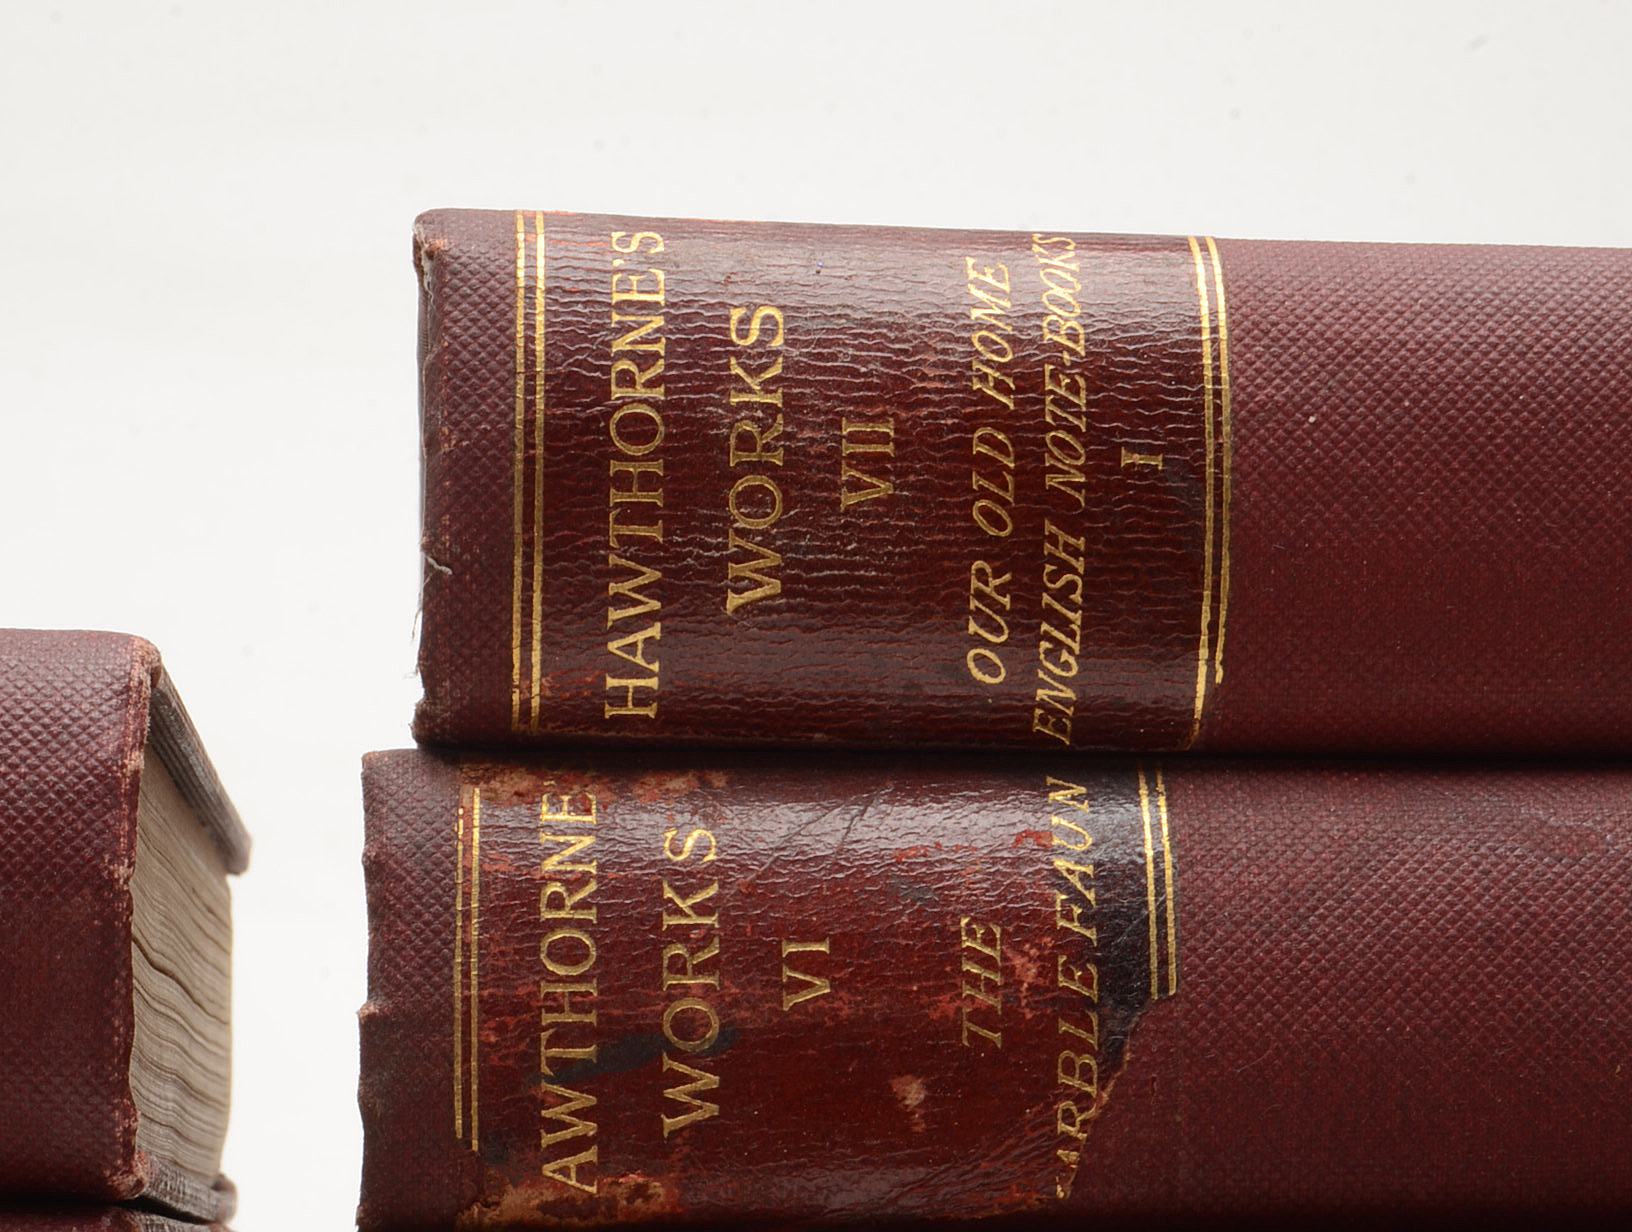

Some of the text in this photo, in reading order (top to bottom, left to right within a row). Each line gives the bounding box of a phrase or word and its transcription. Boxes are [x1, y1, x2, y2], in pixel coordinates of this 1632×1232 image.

[604, 230, 667, 719] HAWTHORNE'S
[726, 304, 785, 616] WORKS
[840, 416, 895, 509] VII
[966, 256, 1016, 685] OUR OLD HOME
[1121, 444, 1165, 471] I
[1033, 516, 1089, 746] ENGLISH
[662, 826, 720, 1138] WORKS
[782, 937, 830, 1012] VI
[961, 915, 1005, 1050] THE
[1046, 776, 1099, 1199] ARBLE FAUN
